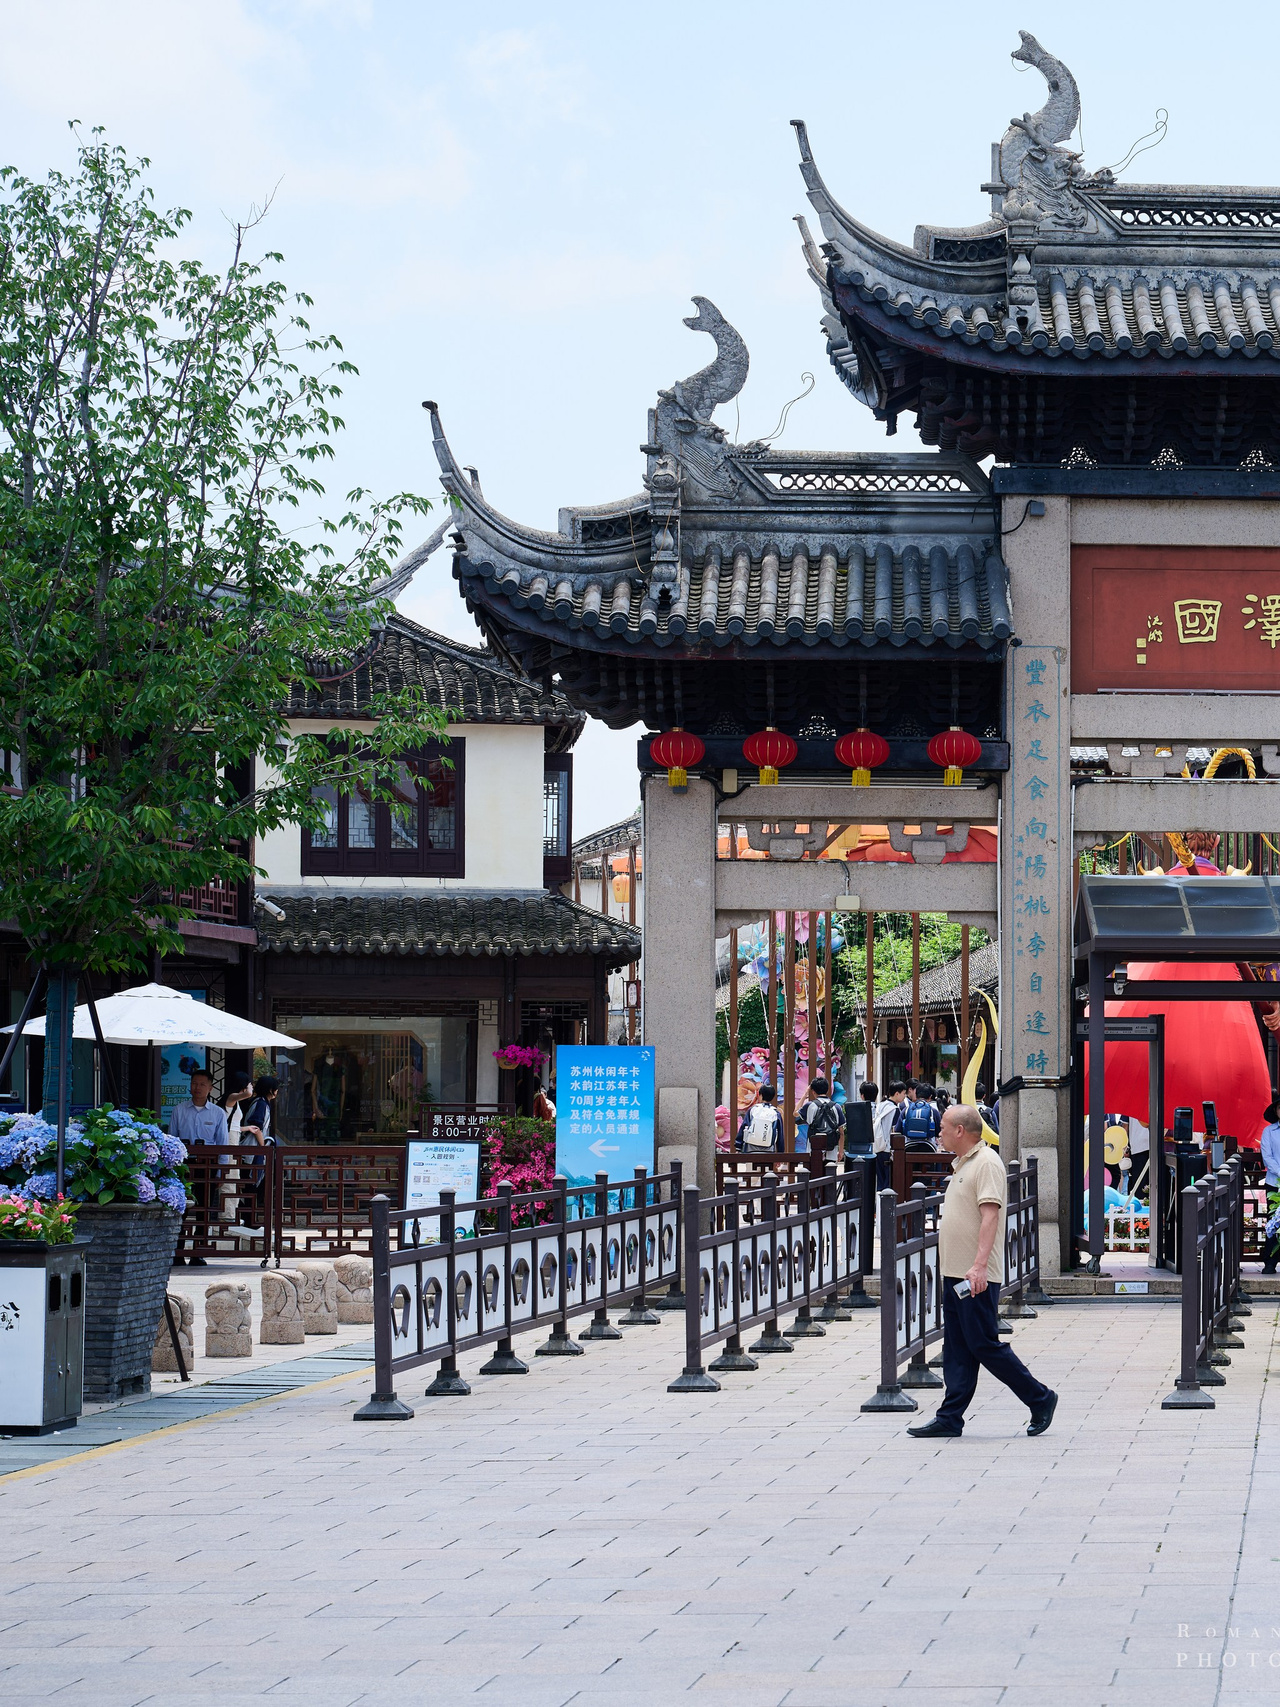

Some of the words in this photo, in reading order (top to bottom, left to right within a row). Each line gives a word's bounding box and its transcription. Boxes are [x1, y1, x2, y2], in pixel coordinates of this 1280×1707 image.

[570, 1066, 640, 1077] 苏州休闲年卡
[570, 1080, 640, 1091] 水韵江苏年卡
[569, 1095, 641, 1106] 70周岁老年人
[569, 1109, 640, 1120] 及符合免票规
[569, 1123, 640, 1134] 定的人员通道
